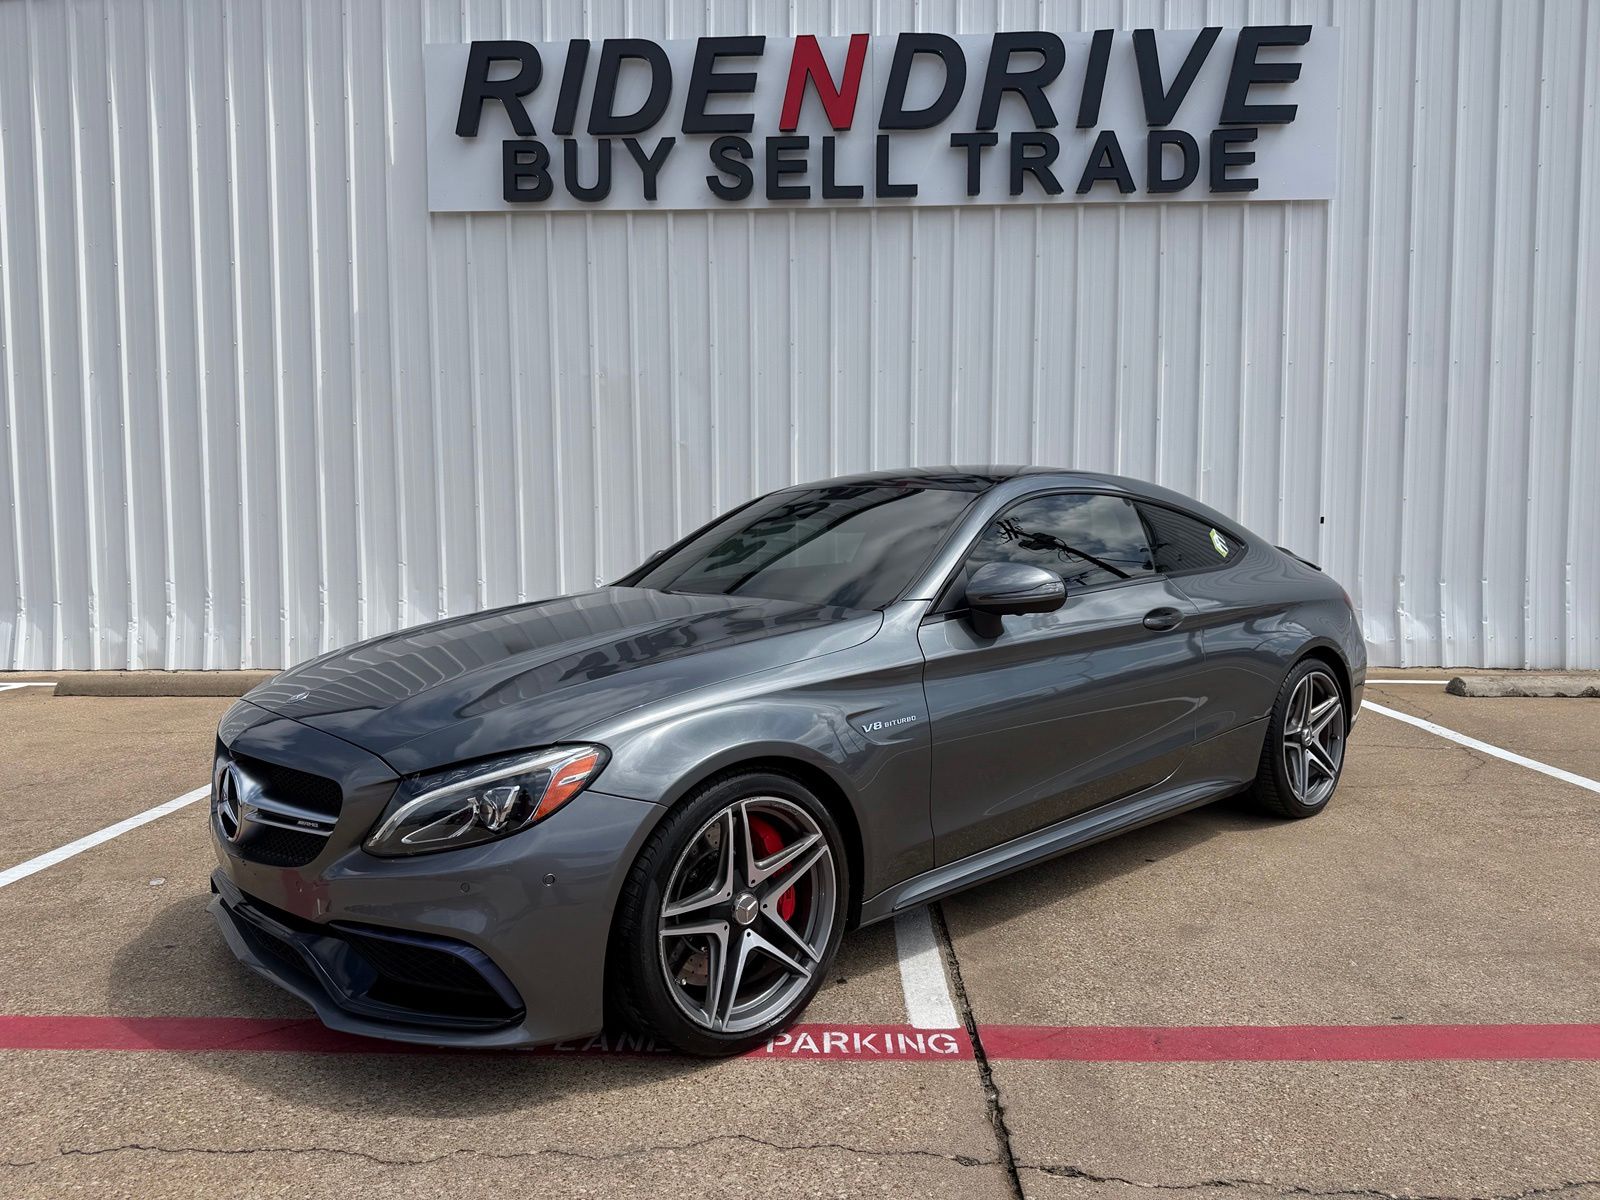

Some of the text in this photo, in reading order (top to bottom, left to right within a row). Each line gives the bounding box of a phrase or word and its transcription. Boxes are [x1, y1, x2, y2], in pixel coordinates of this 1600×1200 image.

[502, 128, 1259, 203] BUY SELL TRADE
[862, 715, 917, 733] V8 BITURBO
[766, 1031, 960, 1055] PARKING
